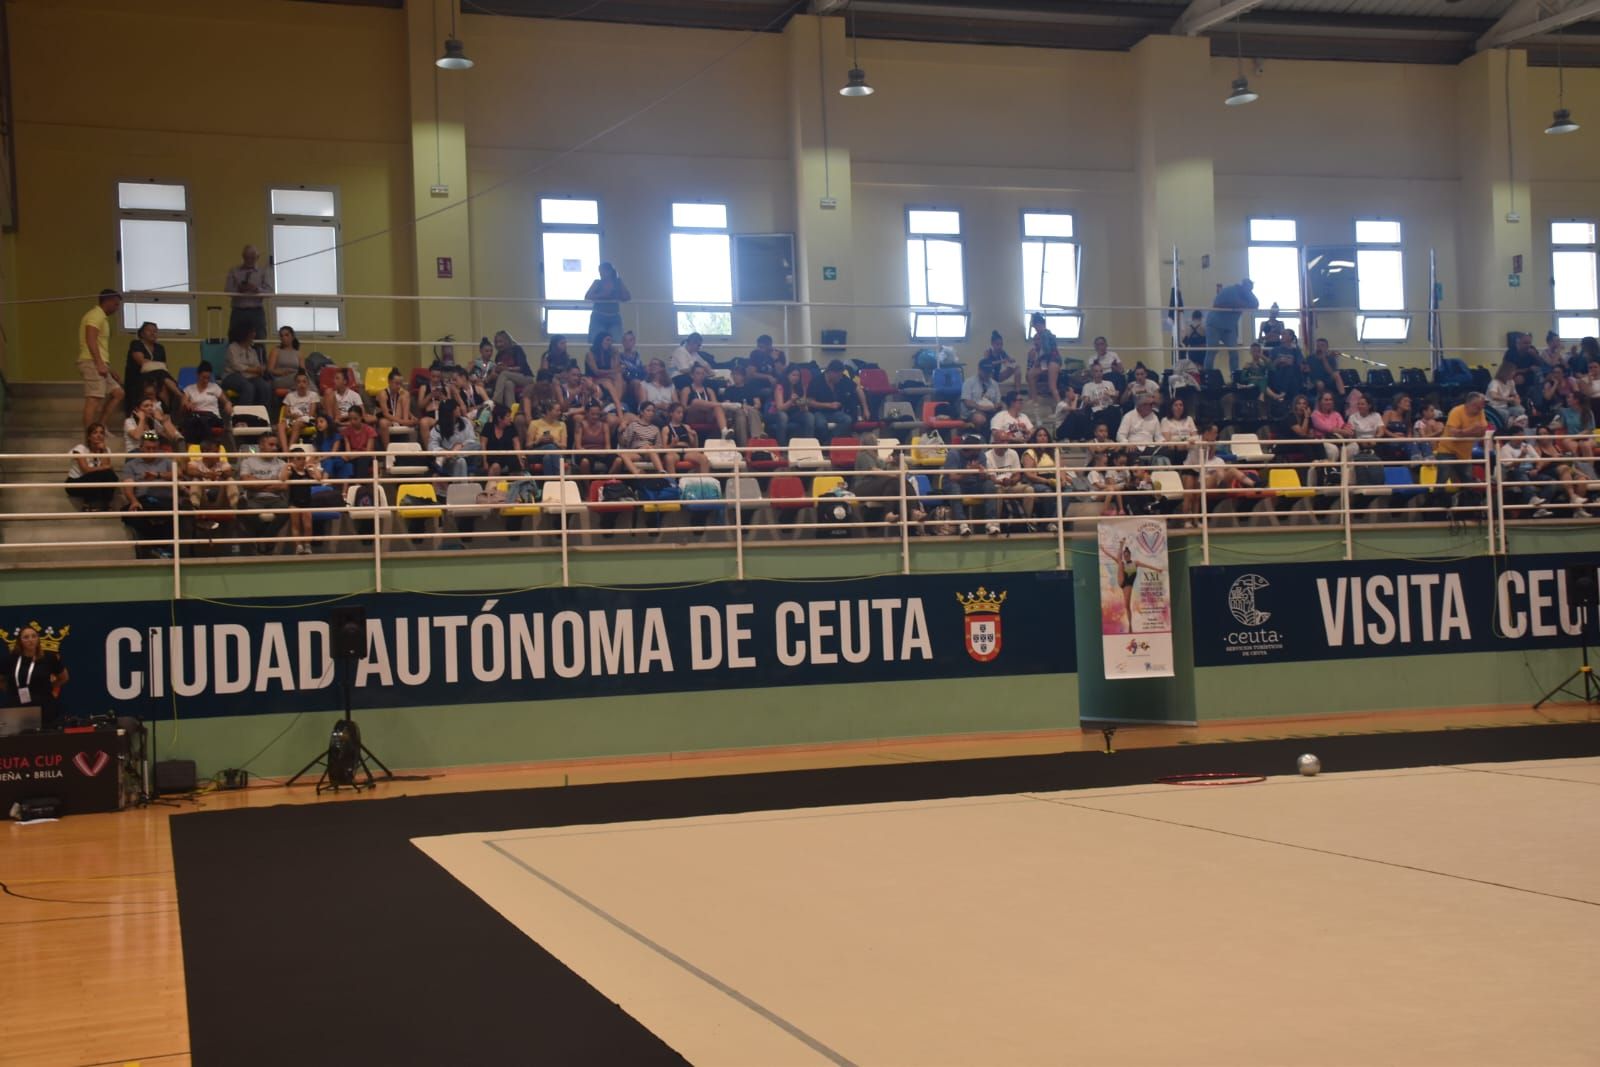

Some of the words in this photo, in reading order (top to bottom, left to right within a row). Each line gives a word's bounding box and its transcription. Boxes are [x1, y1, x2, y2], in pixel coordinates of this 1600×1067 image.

[1316, 572, 1472, 647] VISITA
[1498, 567, 1600, 639] CEU
[105, 620, 336, 701] CIUDAD
[354, 598, 675, 688] AUTÓNOMA
[689, 603, 757, 671] DE
[775, 597, 934, 667] CEUTA
[34, 770, 63, 779] BRILLA
[35, 754, 63, 768] CUP
